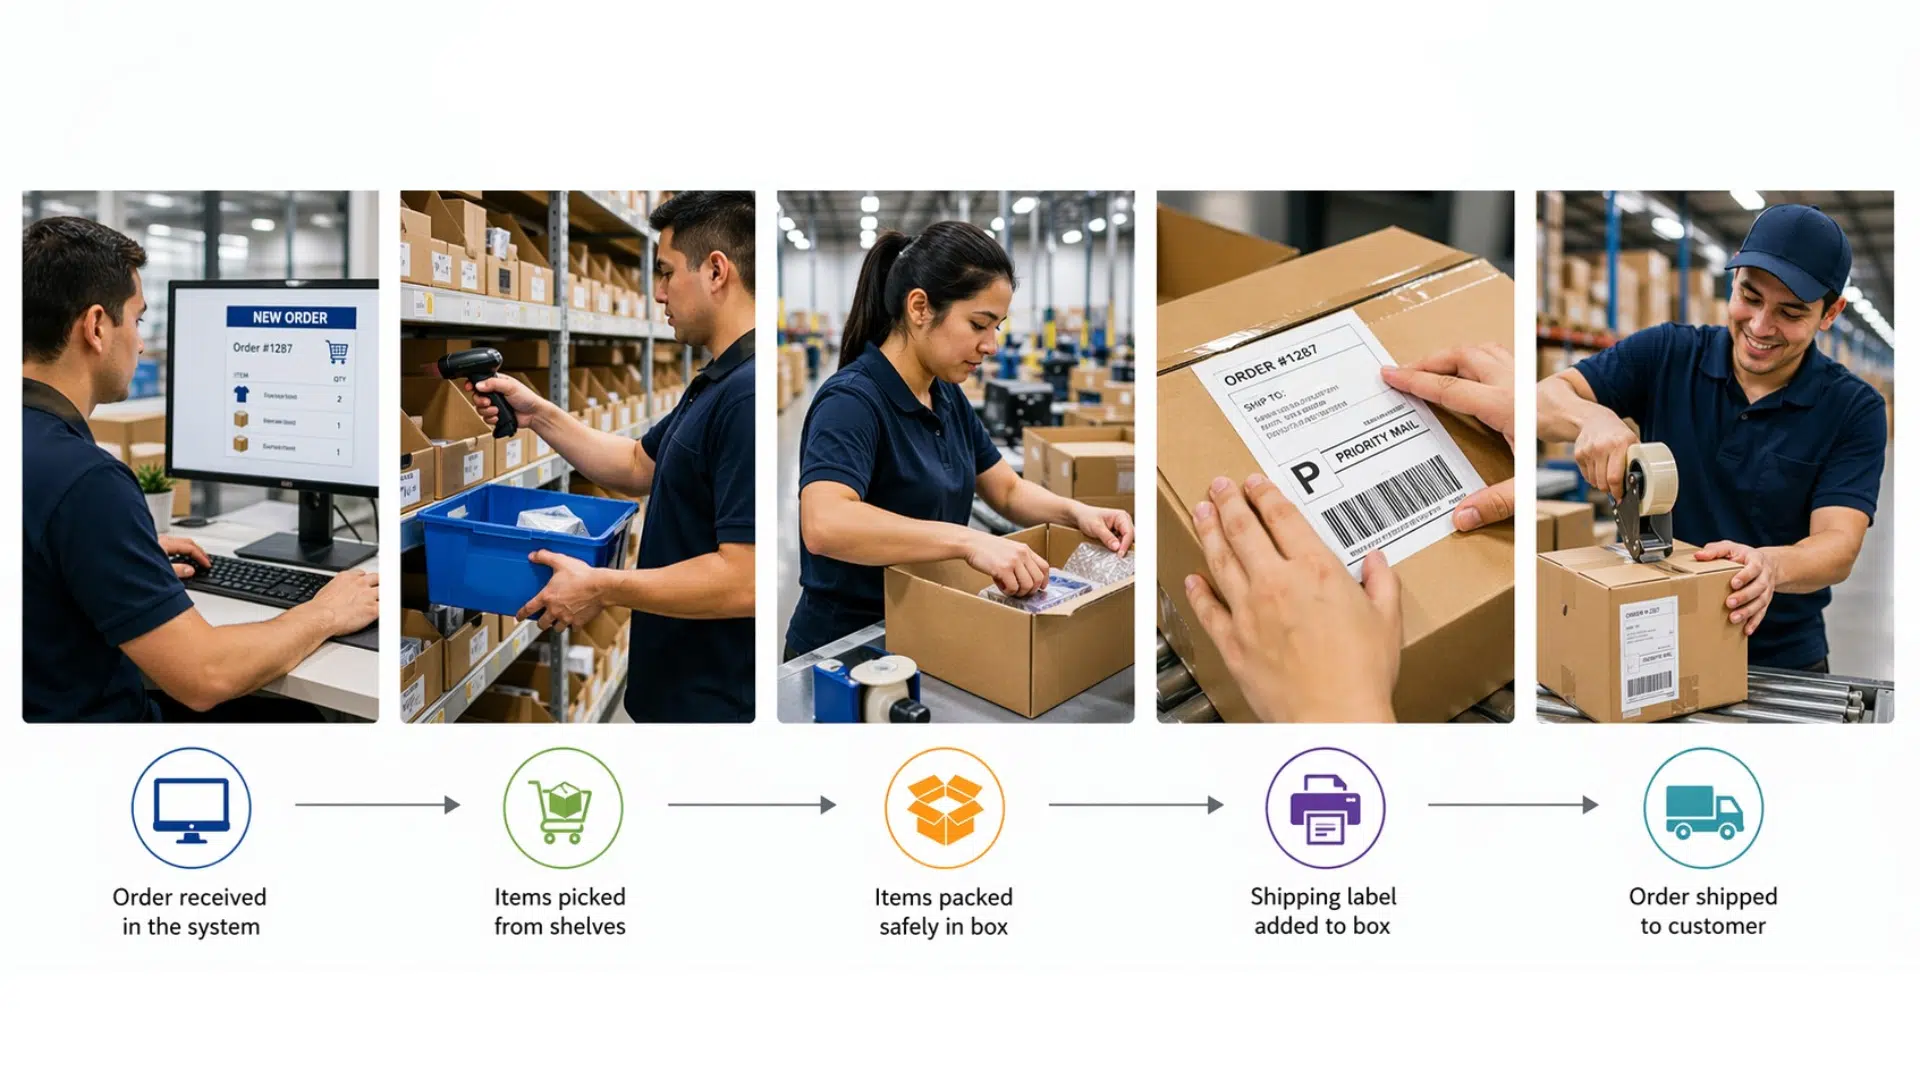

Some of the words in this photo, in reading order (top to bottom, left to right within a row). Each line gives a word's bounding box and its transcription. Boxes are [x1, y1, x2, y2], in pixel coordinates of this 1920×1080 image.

[253, 311, 282, 323] NEW
[285, 312, 328, 324] ORDER
[233, 342, 260, 353] Order
[263, 343, 293, 354] #1287
[1224, 360, 1277, 387] ORDER
[1277, 344, 1318, 367] #1287
[337, 395, 342, 403] 2
[1243, 397, 1267, 412] SHIP
[1267, 390, 1287, 402] TO:
[1335, 432, 1389, 463] PRIORITY
[1389, 420, 1420, 438] MAIL
[1290, 461, 1320, 495] P
